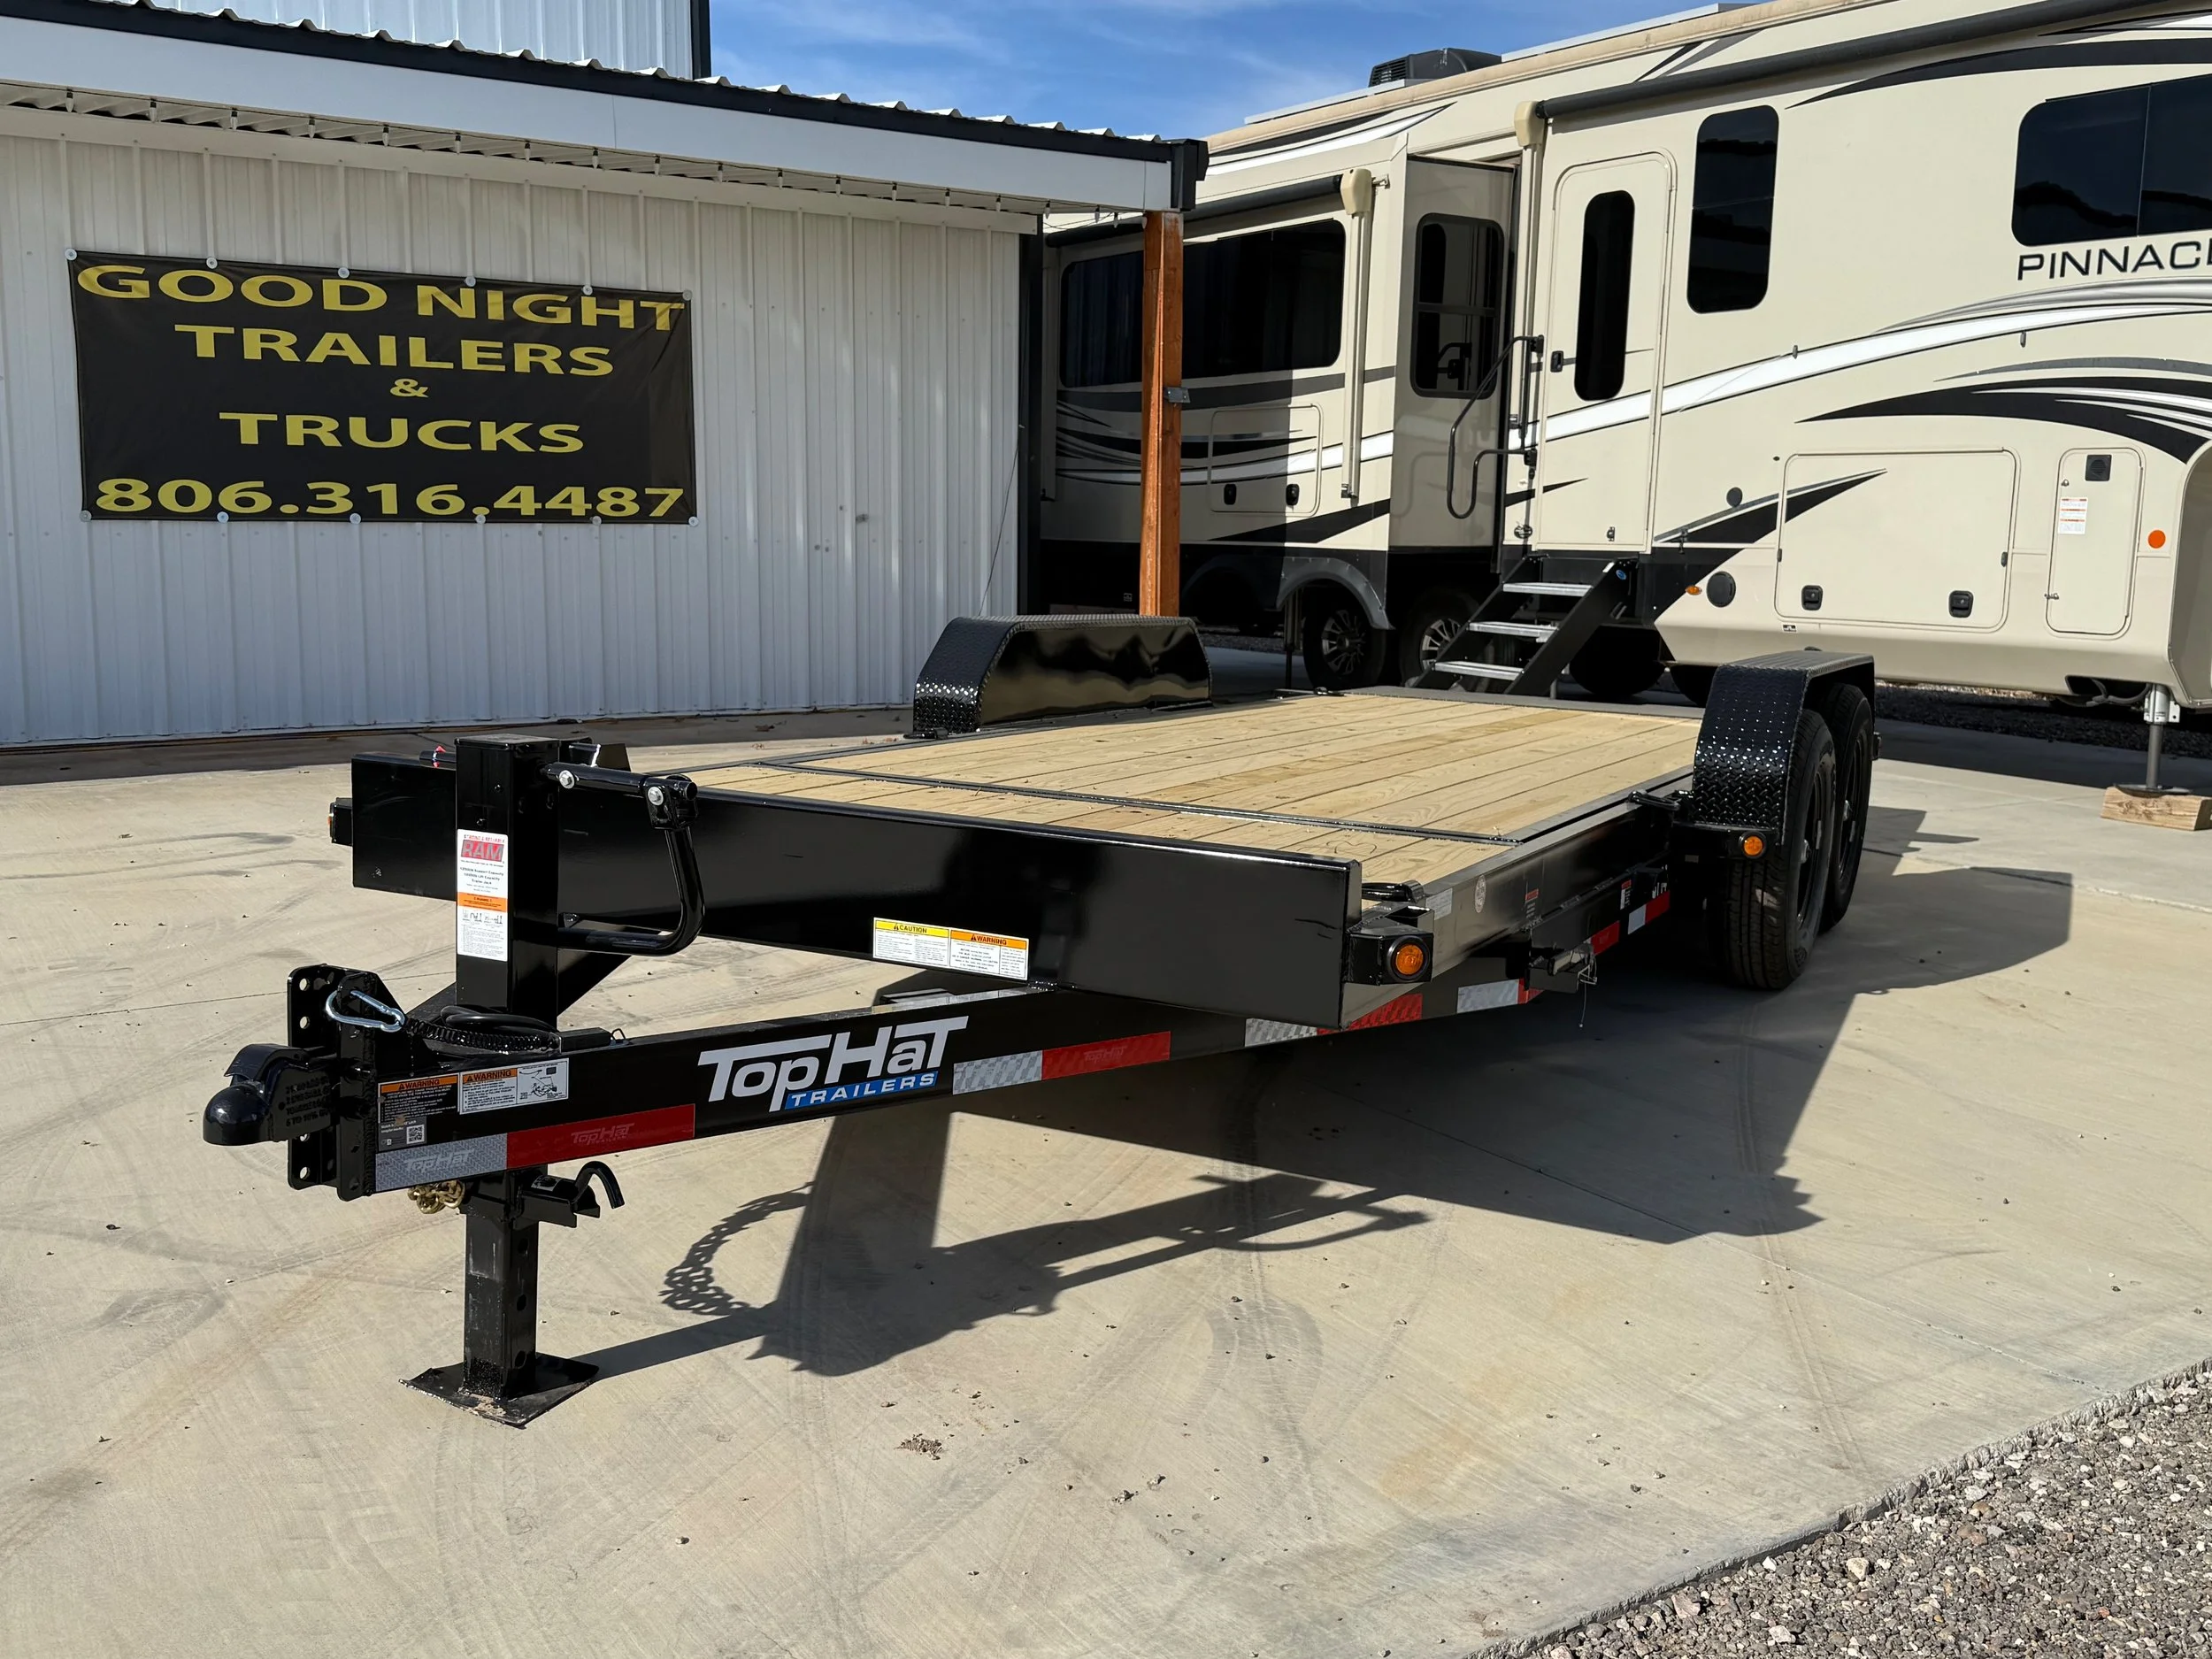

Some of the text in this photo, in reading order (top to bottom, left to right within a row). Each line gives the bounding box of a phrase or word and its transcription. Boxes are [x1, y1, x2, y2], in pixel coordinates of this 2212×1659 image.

[2017, 237, 2212, 280] PINNAC
[77, 264, 685, 332] GOOD NIGHT
[174, 324, 614, 376] TRAILERS
[389, 378, 429, 398] &
[219, 411, 584, 453] TRUCKS
[96, 478, 685, 518] 806.316.4487
[461, 840, 503, 862] RAM
[899, 925, 927, 933] CAUTION
[977, 935, 1007, 946] WARNING
[404, 1079, 440, 1089] WARNING
[472, 1069, 512, 1081] WARNING
[791, 1073, 935, 1107] TRAILERS
